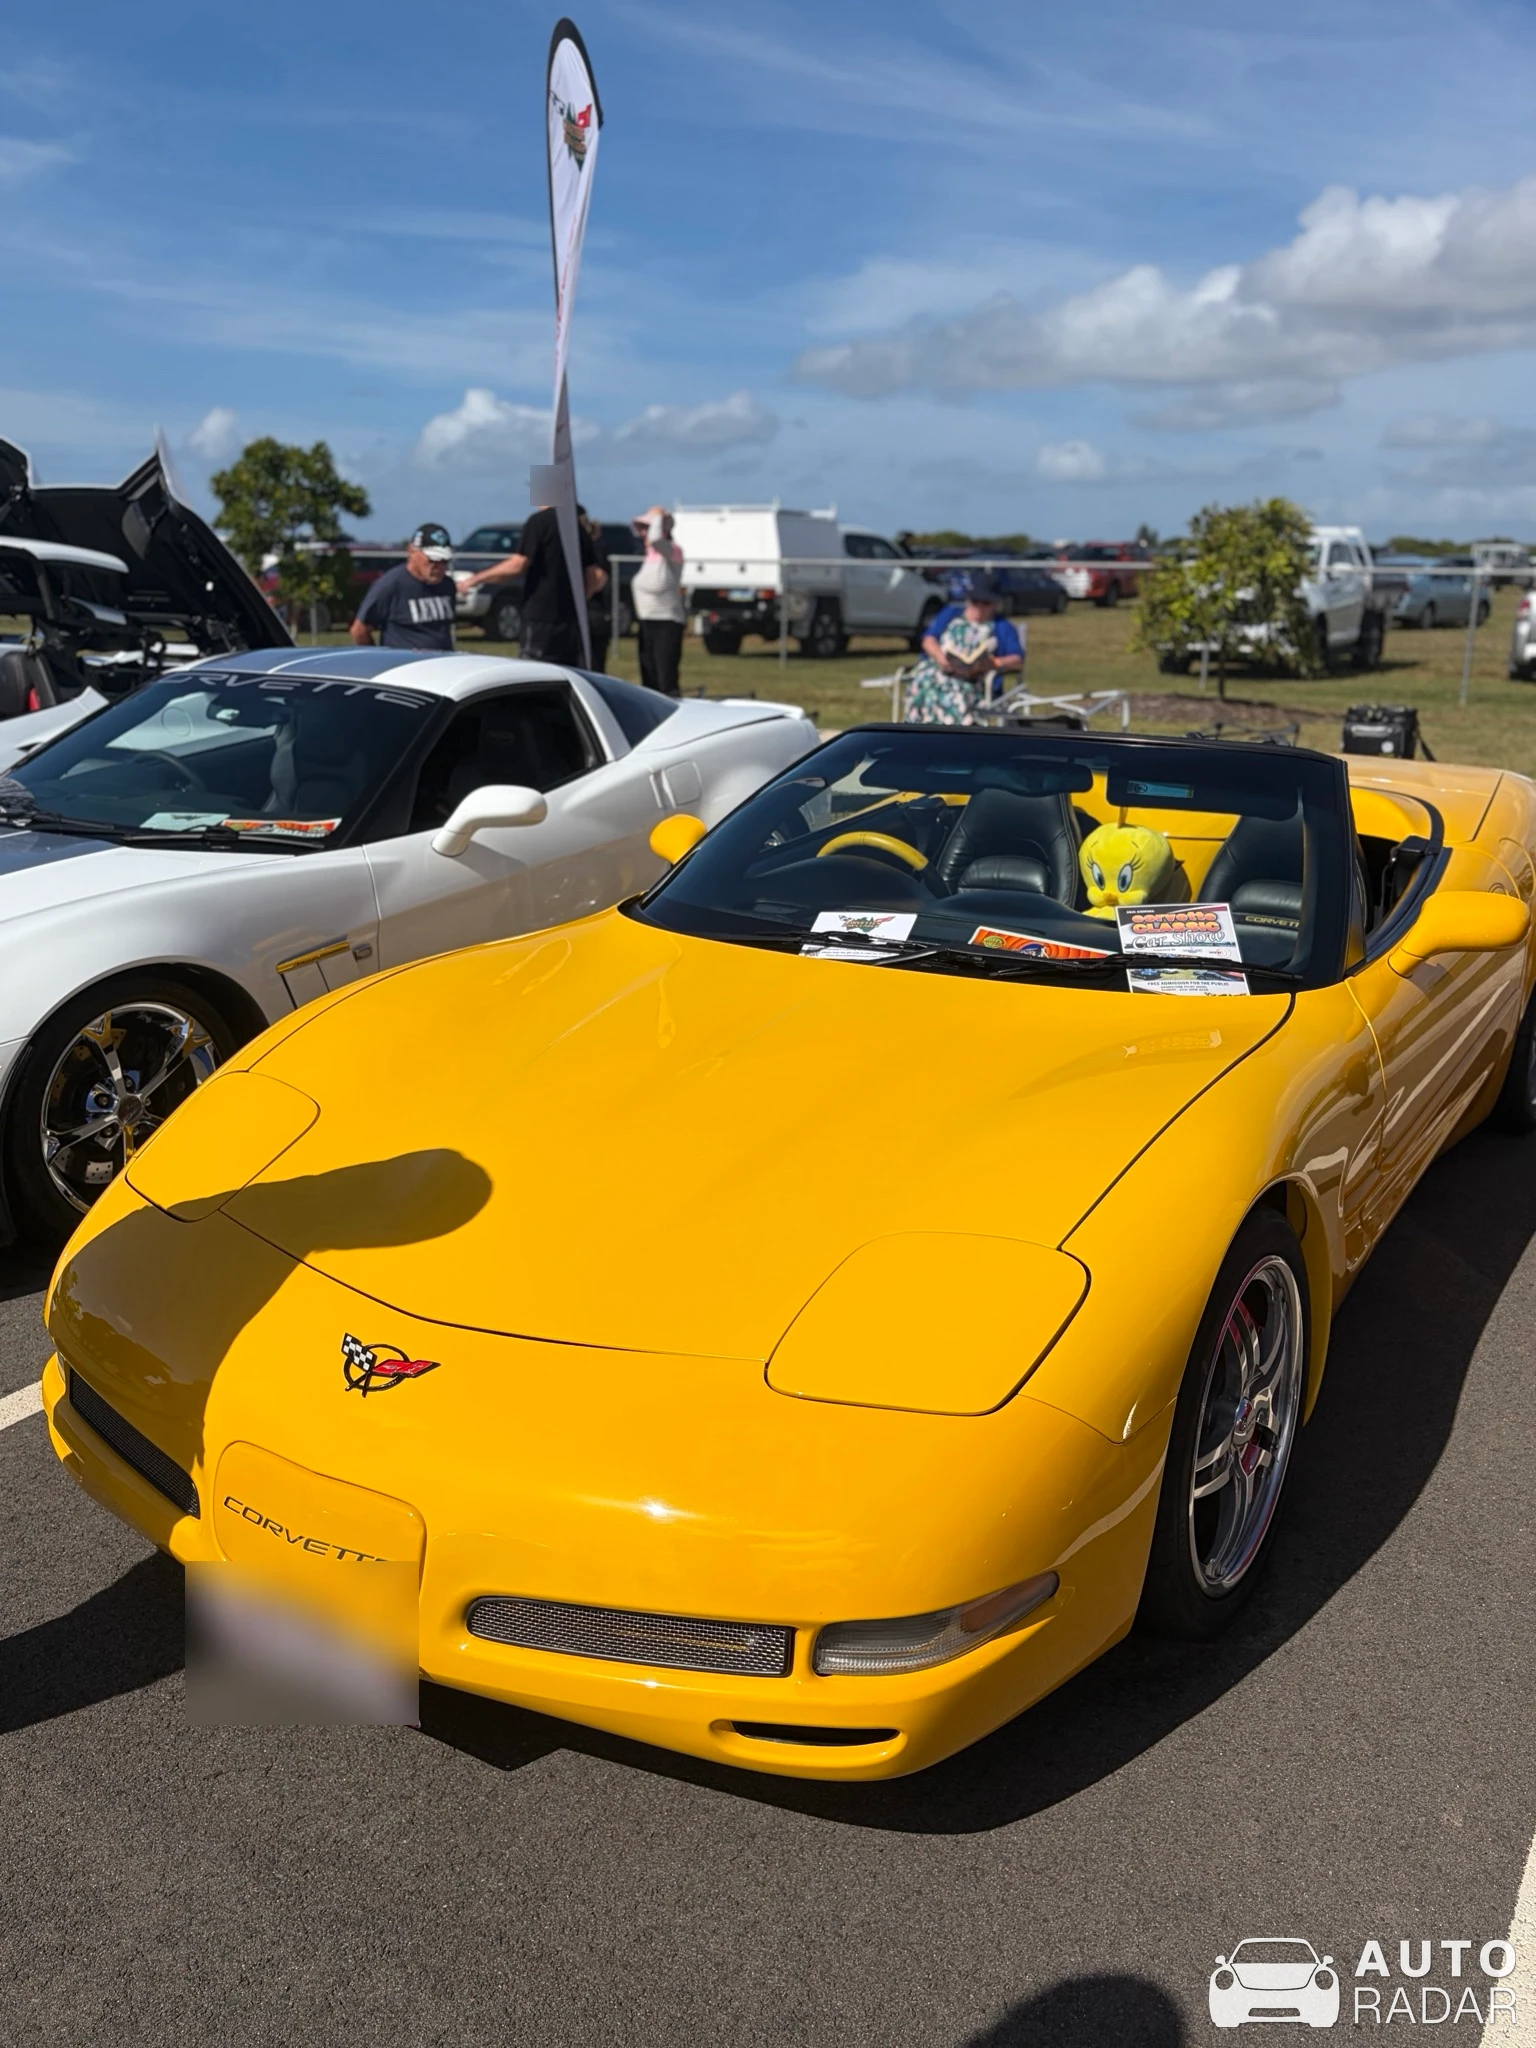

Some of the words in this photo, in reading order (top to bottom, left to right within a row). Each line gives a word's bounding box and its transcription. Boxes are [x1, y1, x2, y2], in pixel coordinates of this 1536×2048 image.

[157, 672, 436, 709] ORVETTE
[1131, 920, 1221, 934] CLASSIC
[1245, 915, 1300, 928] CORVETT
[1132, 935, 1167, 950] Car
[1171, 930, 1225, 946] Show
[223, 1496, 388, 1562] CORVETT
